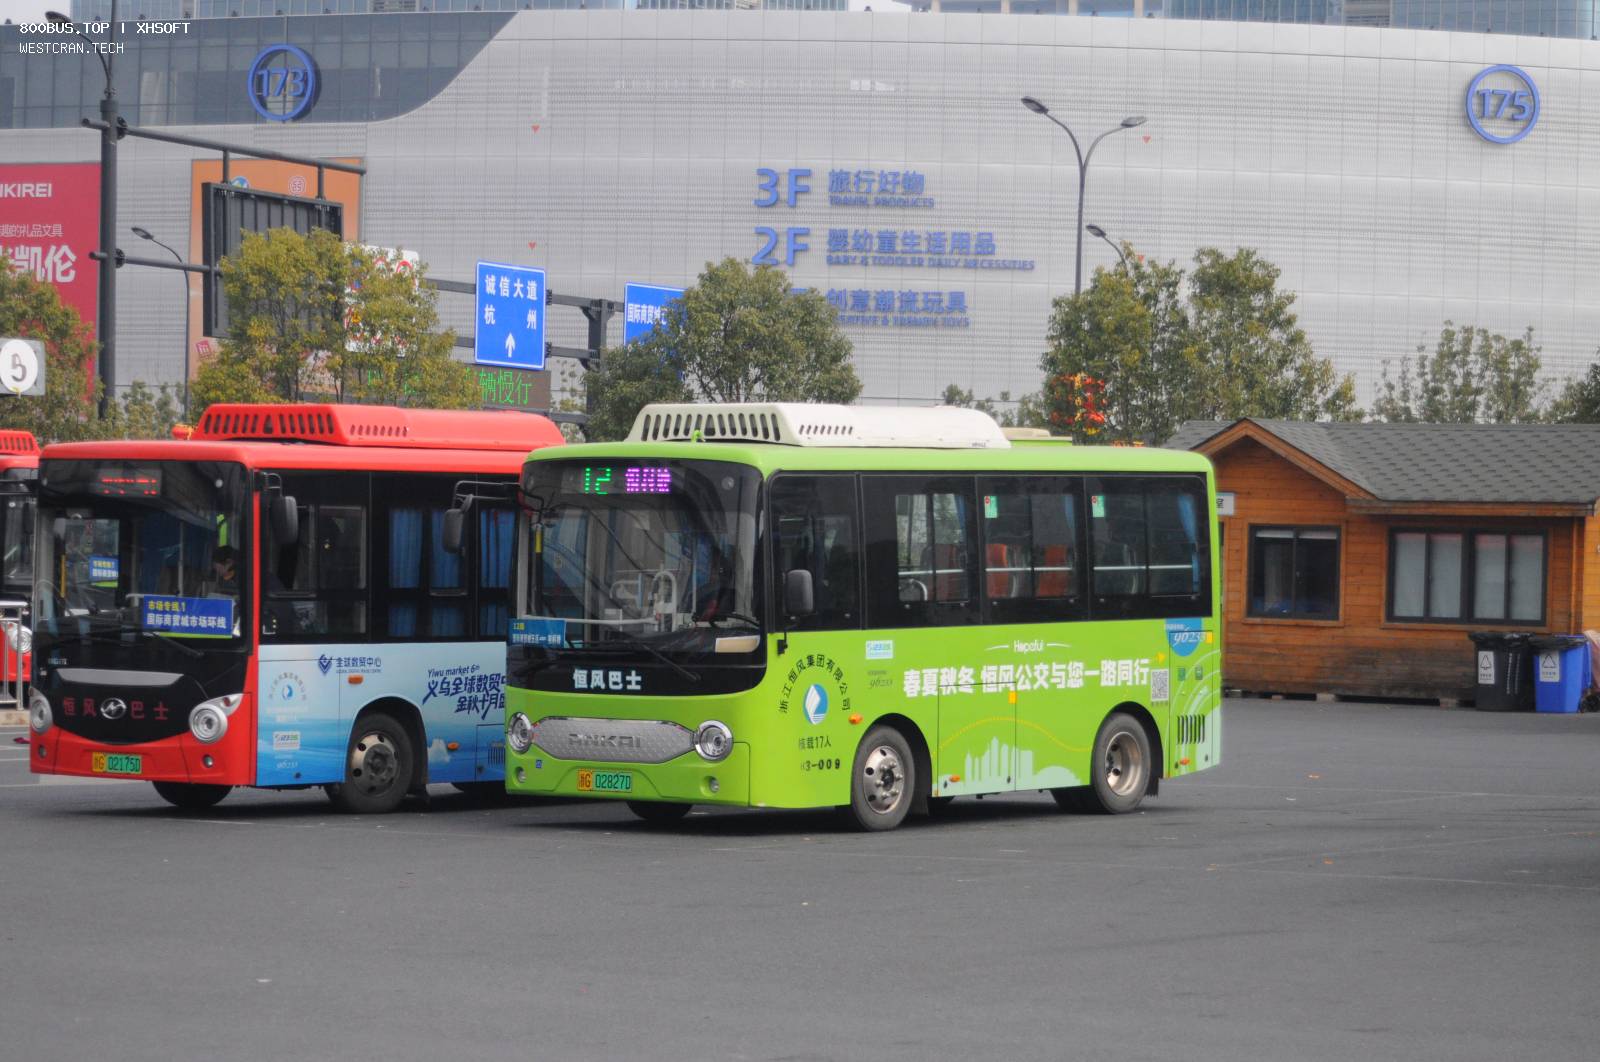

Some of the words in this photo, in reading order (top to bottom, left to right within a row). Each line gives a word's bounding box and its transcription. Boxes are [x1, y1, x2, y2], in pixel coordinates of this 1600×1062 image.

[256, 68, 305, 97] 173
[1477, 89, 1532, 120] 175
[754, 167, 812, 208] 3F
[828, 168, 925, 194] 旅行好物
[751, 226, 811, 267] 2F
[827, 228, 996, 255] 婴幼童生活用品
[0, 244, 77, 283] 凯伦
[826, 254, 856, 266] BABY
[872, 255, 924, 267] TODDLER
[928, 257, 960, 268] DAILY
[485, 274, 538, 301] 诚信大道
[827, 288, 968, 313] 创意潮流玩具
[584, 467, 612, 495] 12
[428, 669, 444, 678] Yiwu
[445, 666, 470, 676] market
[573, 668, 642, 690] 恒风巴士
[779, 654, 851, 714] 浙江恒风集团有限公司
[903, 666, 976, 698] 春夏秋冬
[981, 658, 1149, 693] 恒风公交与您一路同行
